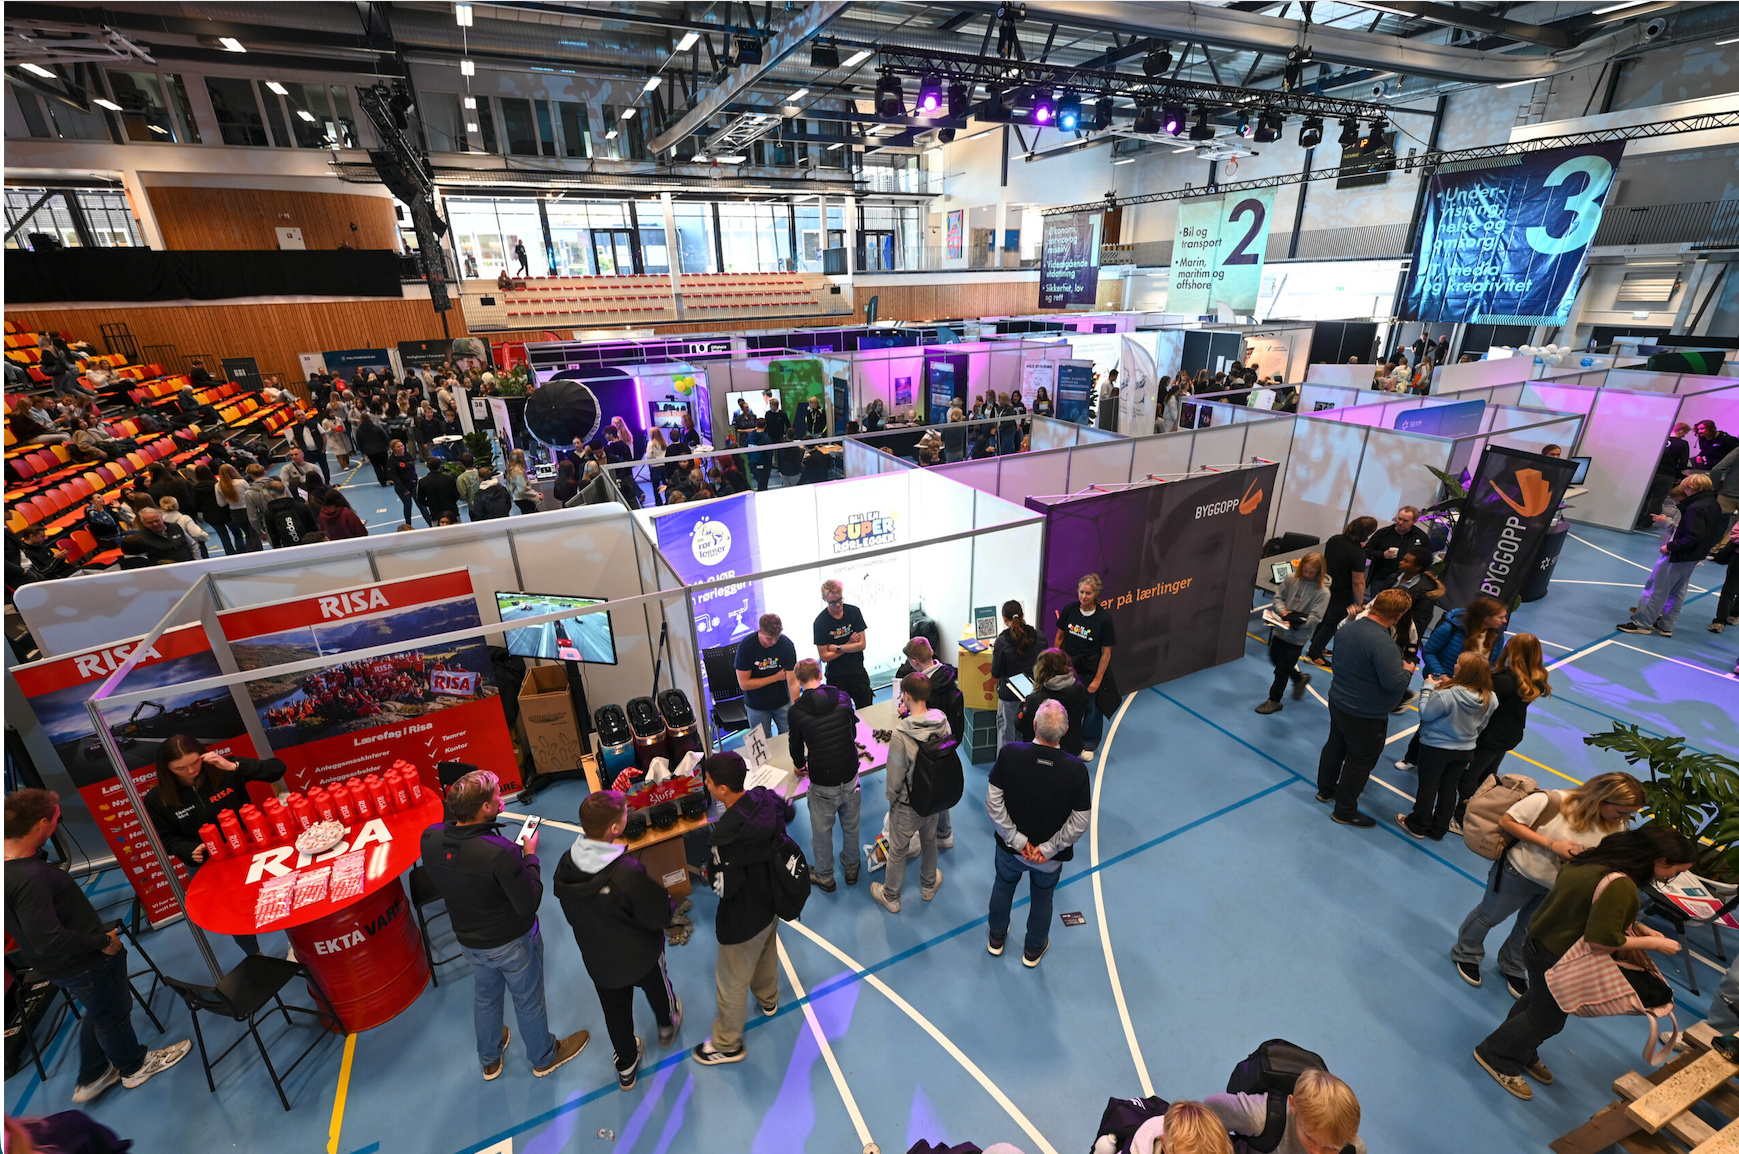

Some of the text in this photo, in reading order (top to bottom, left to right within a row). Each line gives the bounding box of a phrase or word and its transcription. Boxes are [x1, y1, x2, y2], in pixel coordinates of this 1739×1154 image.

[1446, 184, 1505, 202] Under-
[1526, 155, 1612, 254] 3
[1183, 226, 1208, 239] Bil og
[1222, 198, 1266, 266] 2
[1484, 219, 1506, 234] og
[1089, 213, 1102, 267] 1
[1181, 238, 1222, 250] transport
[1047, 258, 1088, 269] Videregående
[1179, 256, 1207, 268] Marin,
[1448, 260, 1499, 276] media
[1178, 268, 1225, 281] maritim og
[1045, 283, 1084, 293] Sikkerhet, lov
[1176, 279, 1212, 290] offshore
[1422, 278, 1533, 295] og kreativitet
[1045, 293, 1064, 303] og rett
[1195, 499, 1240, 519] BYGGOPP
[833, 517, 896, 543] SUPER
[698, 541, 712, 550] rør
[833, 533, 896, 553] RØRLEGGER
[699, 544, 726, 558] legger
[1480, 515, 1527, 597] BYGGOPP
[1116, 590, 1132, 610] på
[1136, 578, 1193, 601] lærlinger
[318, 587, 390, 619] RISA
[74, 640, 162, 679] RISA
[374, 663, 394, 673] RISA
[434, 676, 470, 690] RISA
[354, 730, 402, 746] Lærefag
[408, 722, 433, 734] Risa
[442, 730, 467, 742] Tømrer
[444, 742, 468, 754] Kontor
[314, 750, 390, 773] Anleggsmaskinfører
[320, 766, 382, 785] Anleggsarbeider
[210, 788, 234, 804] RISA
[398, 790, 407, 804] RISA
[412, 784, 422, 800] RISA
[358, 800, 368, 814] RISA
[376, 795, 387, 810] RISA
[340, 805, 350, 820] RISA
[252, 829, 264, 842] RISA
[276, 822, 288, 836] RISA
[206, 840, 218, 856] RISA
[228, 834, 240, 850] RISA
